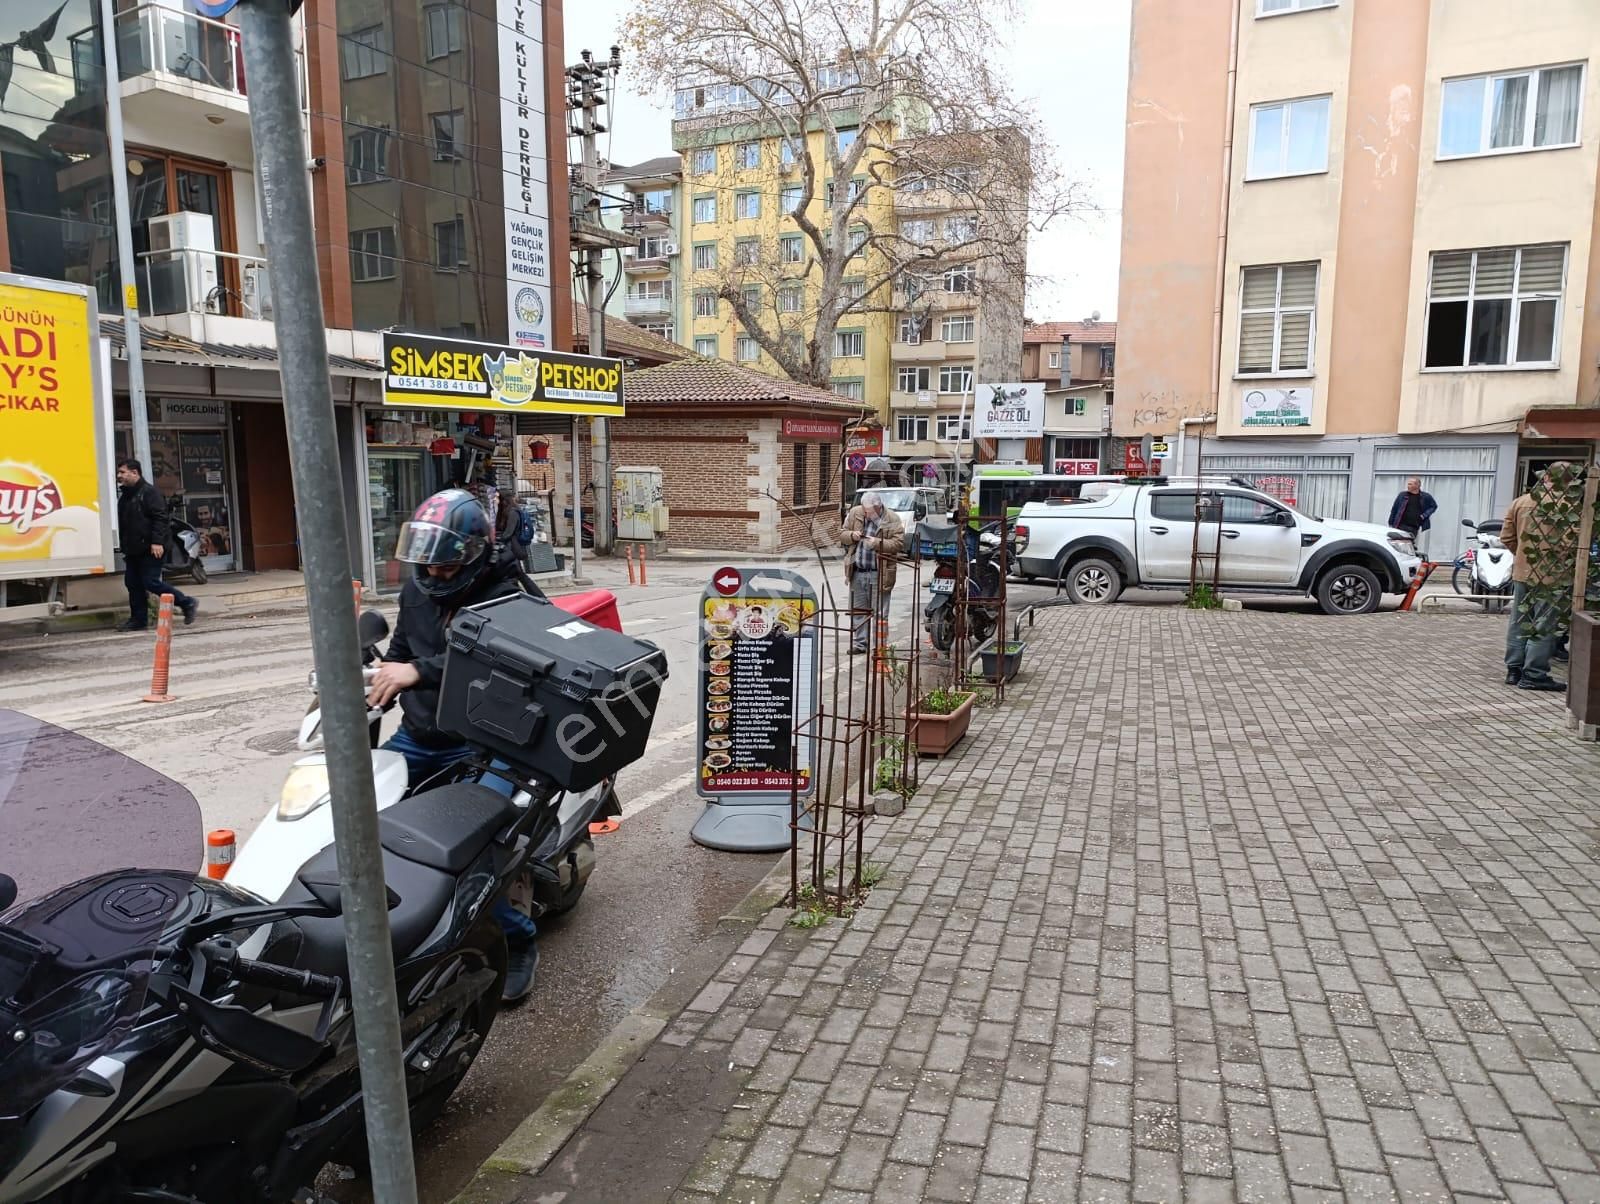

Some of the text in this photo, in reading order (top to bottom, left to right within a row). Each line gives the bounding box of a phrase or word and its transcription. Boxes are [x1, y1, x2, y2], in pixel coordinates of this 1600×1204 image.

[515, 41, 528, 119] KÜLTÜR
[518, 127, 532, 214] DERNEĞİ
[510, 222, 543, 238] YAĞMUR
[511, 236, 544, 251] GENÇLİK
[511, 250, 544, 264] GELİŞİM
[512, 263, 544, 277] MERKEZİ
[0, 303, 55, 327] ÜNÜN
[541, 361, 620, 391] PETSHOP
[399, 378, 480, 391] 0541 388 41 61
[505, 382, 532, 394] PETSHOP
